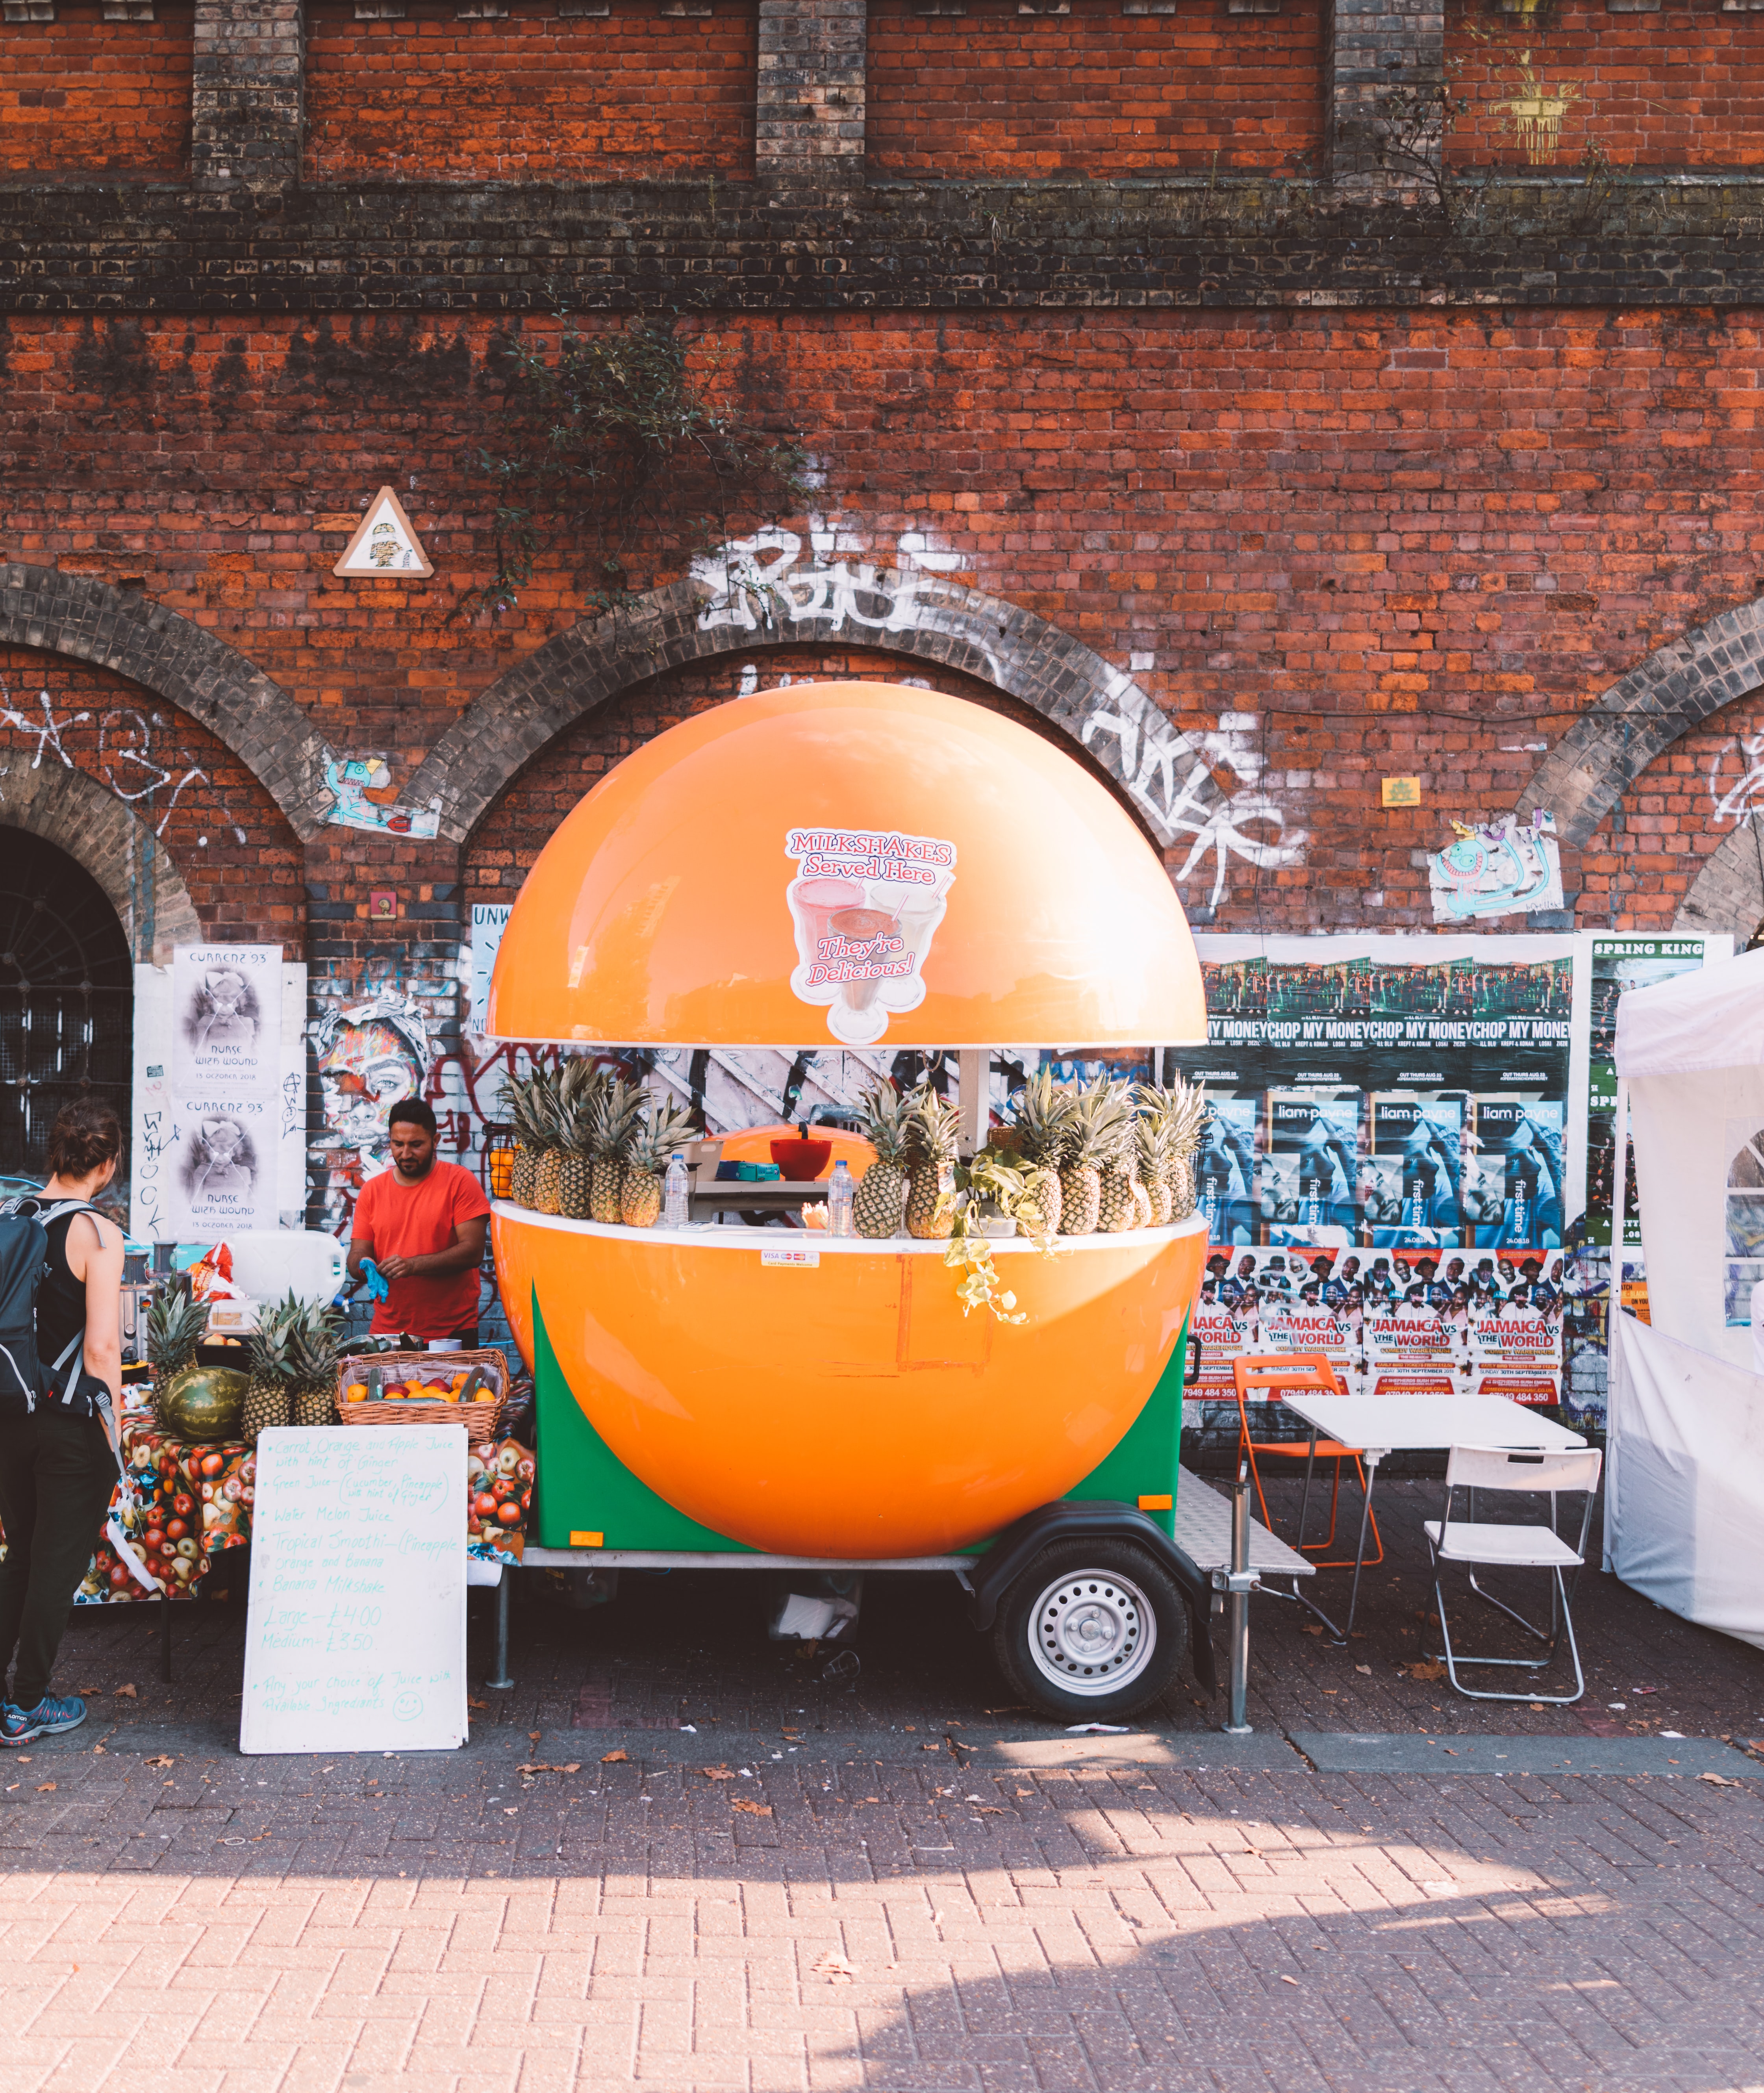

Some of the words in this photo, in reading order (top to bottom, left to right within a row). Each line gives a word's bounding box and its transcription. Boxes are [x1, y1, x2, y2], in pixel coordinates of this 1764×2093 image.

[793, 834, 951, 865] MILKSHAKES
[806, 855, 879, 877] Served
[884, 860, 934, 883] Here
[819, 932, 902, 960] They're
[1594, 943, 1655, 955] SPRING
[1661, 943, 1704, 955] KING
[808, 954, 914, 985] Delicious!
[1223, 1021, 1267, 1038] MONEY
[1267, 1021, 1301, 1039] CHOP
[1303, 1021, 1323, 1039] MY
[1326, 1021, 1370, 1039] MONEY
[1370, 1021, 1404, 1038] CHOP
[1406, 1021, 1426, 1038] MY
[1429, 1021, 1473, 1038] MONEY
[1473, 1021, 1506, 1039] CHOP
[1509, 1021, 1529, 1038] MY
[211, 1045, 242, 1055] NURSE
[195, 1057, 220, 1065] WITH
[223, 1058, 258, 1066] WOUND
[1209, 1107, 1251, 1120] payne
[1279, 1105, 1308, 1118] liam
[1310, 1108, 1353, 1121] payne
[1381, 1106, 1410, 1119] liam
[1413, 1109, 1456, 1122] payne
[1483, 1106, 1512, 1119] liam
[1515, 1109, 1558, 1122] payne
[1206, 1176, 1218, 1201] first
[1310, 1177, 1321, 1202] first
[1413, 1179, 1424, 1203] first
[1515, 1179, 1526, 1203] first
[208, 1195, 239, 1204] NURSE
[192, 1206, 216, 1214] WITH
[219, 1207, 254, 1215] WOUND
[1514, 1204, 1525, 1233] time
[1268, 1317, 1336, 1331] JAMAICA
[1373, 1319, 1442, 1332] JAMAICA
[1477, 1320, 1546, 1333] JAMAICA
[1548, 1326, 1559, 1334] VS
[1292, 1333, 1345, 1345] WORLD
[1397, 1335, 1450, 1346] WORLD
[1501, 1335, 1554, 1347] WORLD
[318, 1438, 360, 1456] Orange
[366, 1439, 385, 1450] and
[387, 1436, 419, 1455] Apple
[425, 1437, 454, 1450] Juice
[276, 1457, 298, 1467] with
[308, 1456, 331, 1468] hint
[338, 1455, 354, 1470] of
[358, 1455, 398, 1474] Ginger
[272, 1475, 300, 1496] Green
[275, 1509, 306, 1522] Water
[317, 1507, 350, 1521] Melon
[358, 1508, 394, 1522] Juice
[272, 1531, 322, 1557] Tropical
[322, 1553, 340, 1567] and
[345, 1552, 384, 1568] Banana
[272, 1574, 317, 1592] Banana
[324, 1574, 387, 1594] Milkshake
[263, 1675, 286, 1699] Any
[290, 1678, 320, 1696] your
[368, 1672, 385, 1696] of
[391, 1670, 422, 1689] Juice
[430, 1670, 452, 1683] with
